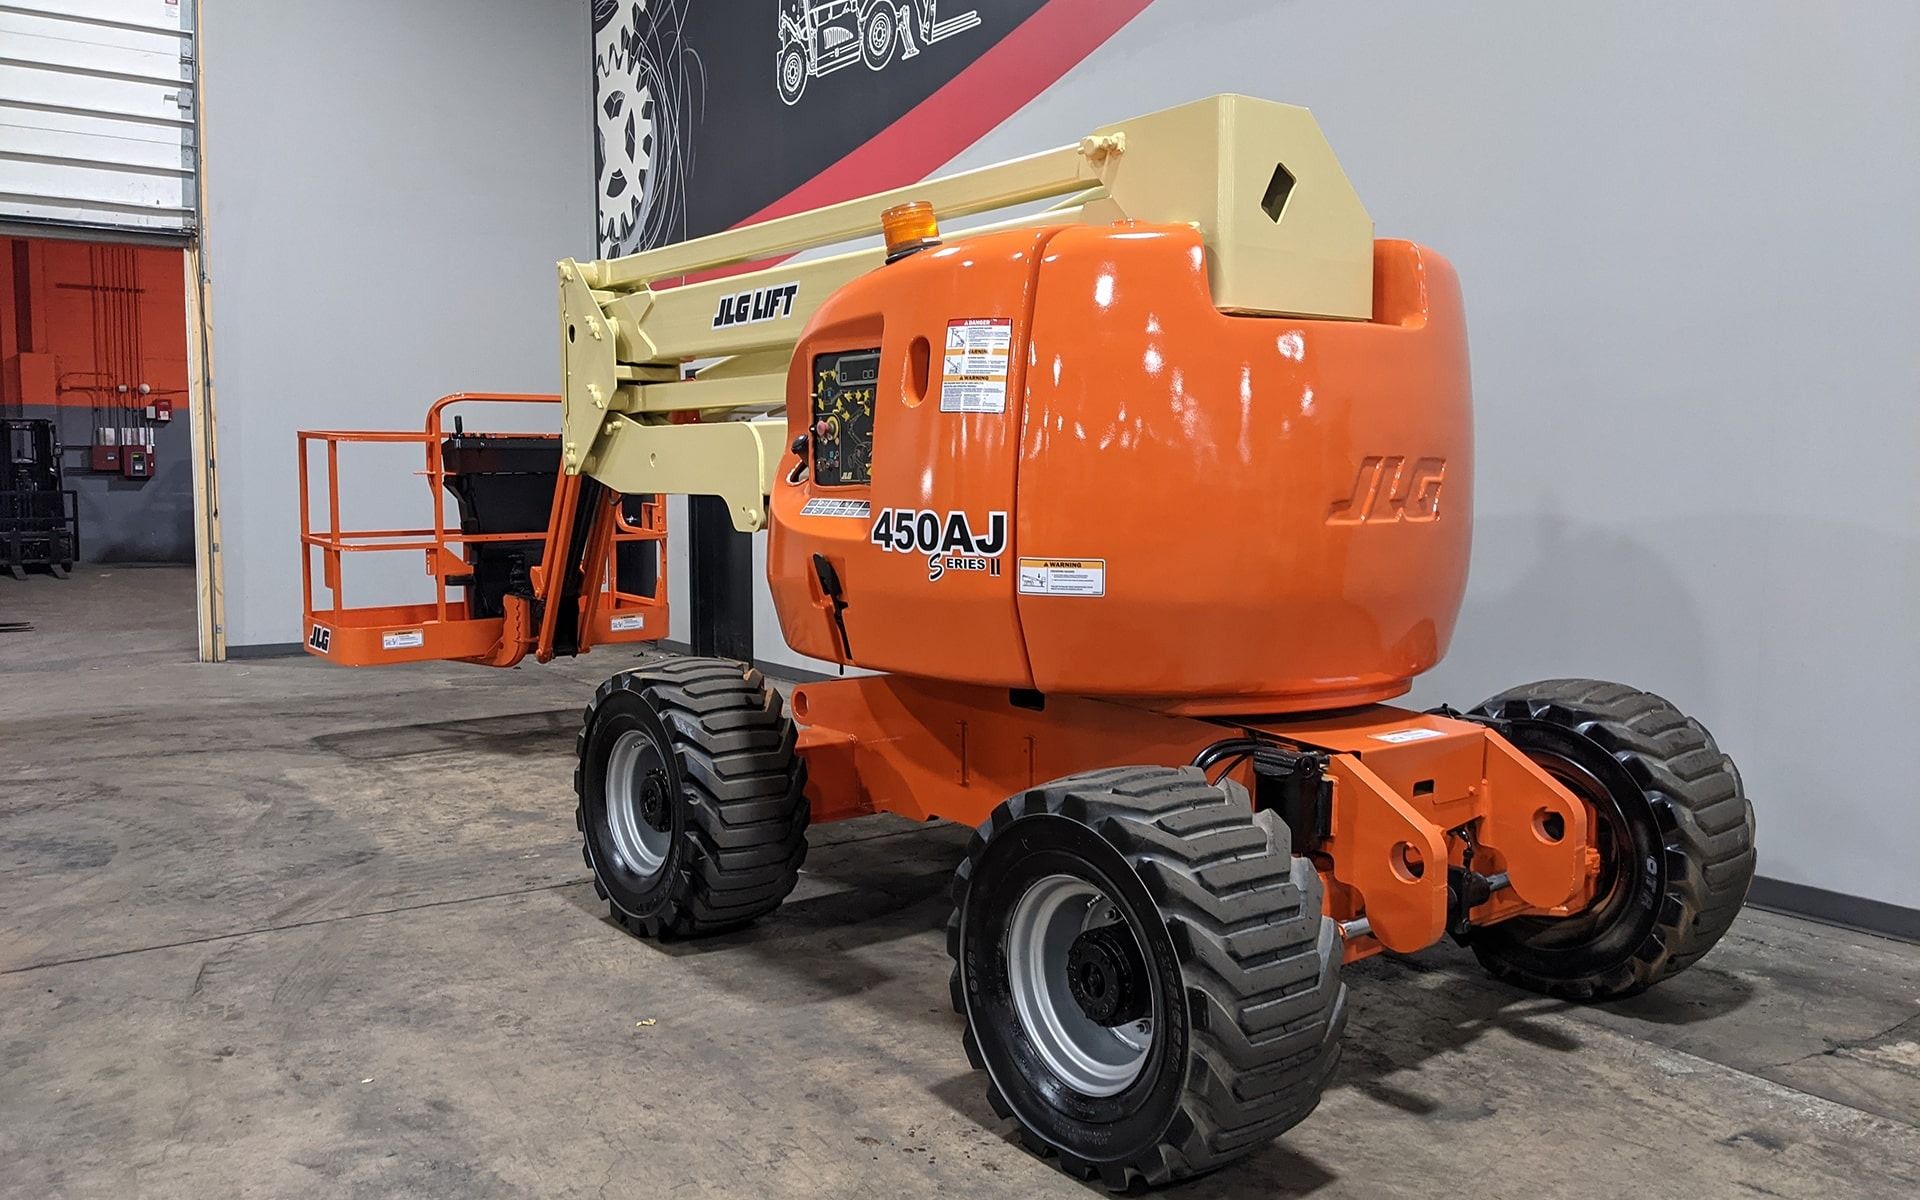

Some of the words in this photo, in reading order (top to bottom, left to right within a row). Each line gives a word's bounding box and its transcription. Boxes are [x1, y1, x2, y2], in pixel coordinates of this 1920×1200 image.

[713, 293, 752, 326] JLG
[754, 285, 798, 321] LIFT
[1326, 456, 1447, 525] JLG
[872, 509, 1006, 555] 450AJ
[990, 558, 1001, 576] II
[1049, 561, 1082, 569] WARNING
[310, 626, 330, 652] JLG
